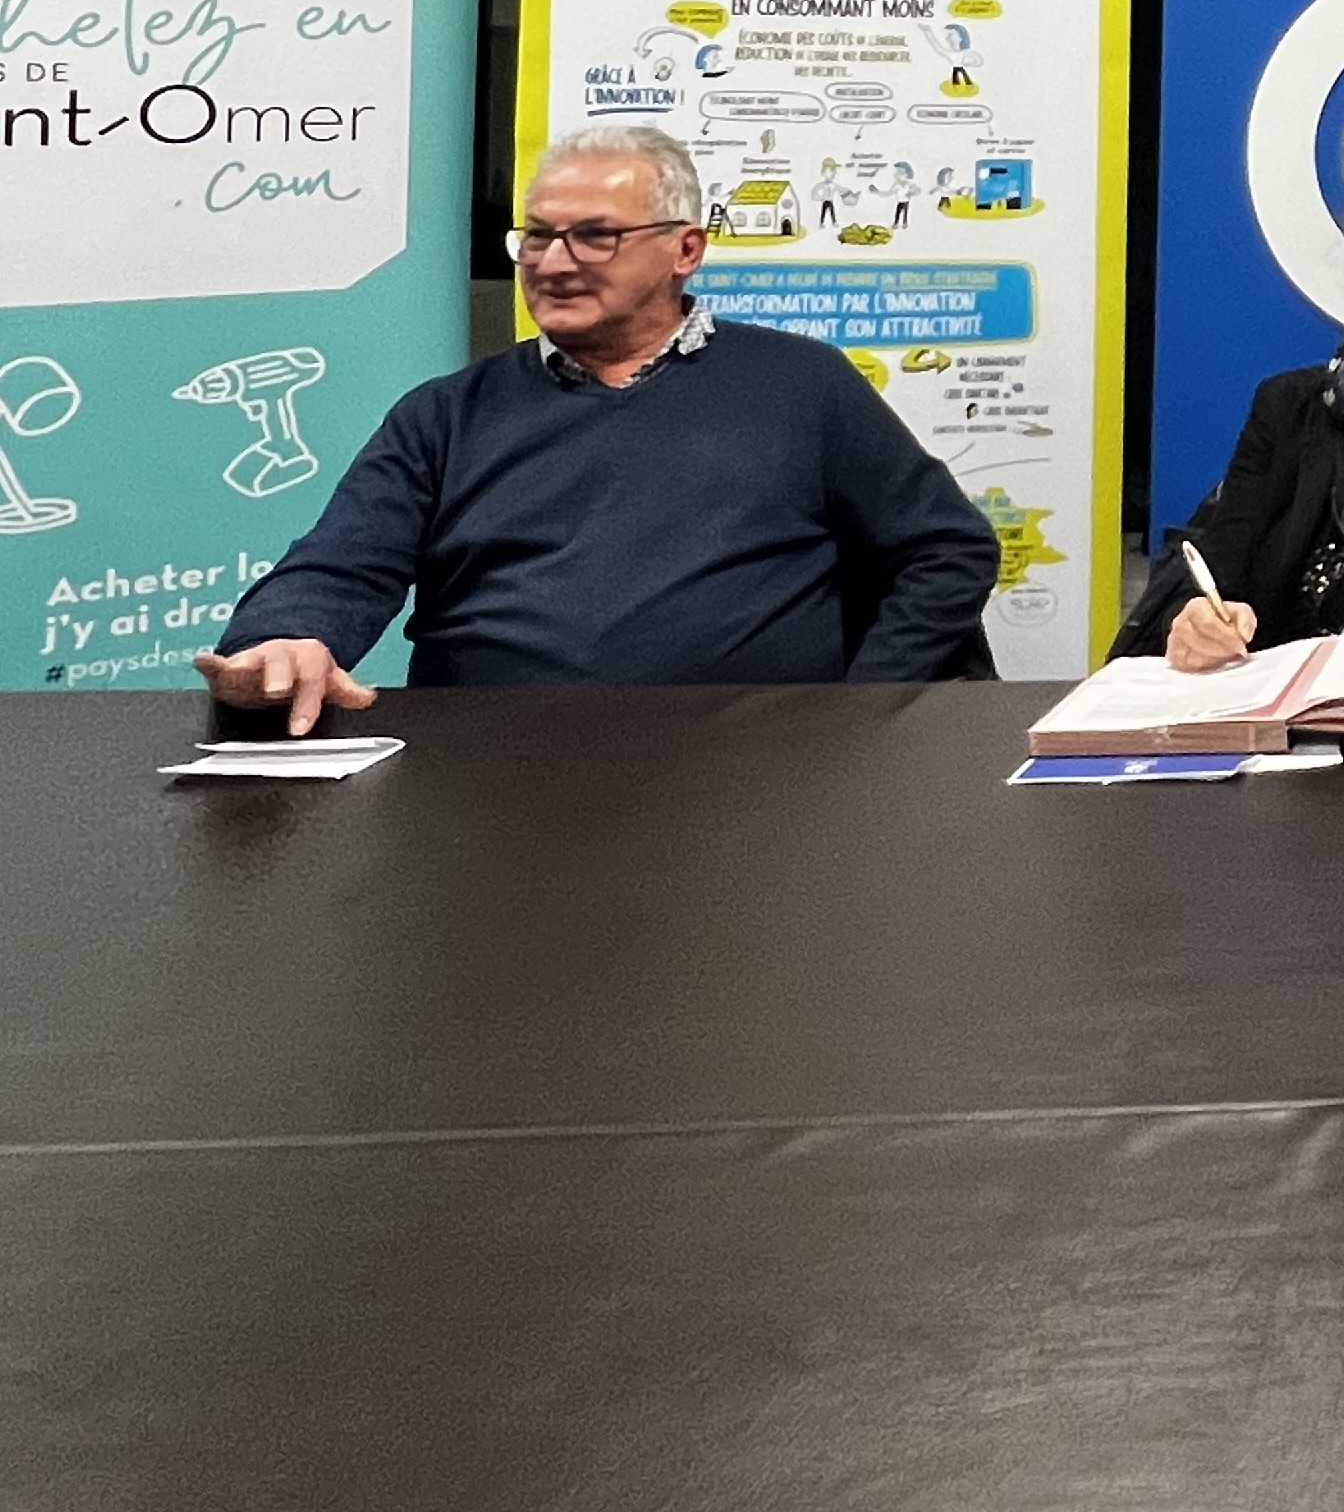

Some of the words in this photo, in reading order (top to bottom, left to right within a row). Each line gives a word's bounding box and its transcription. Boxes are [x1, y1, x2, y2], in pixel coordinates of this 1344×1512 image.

[297, 6, 391, 39] en
[882, 0, 935, 18] MOINS
[26, 62, 69, 82] DE
[46, 563, 225, 606] Acheter
[40, 614, 95, 655] j'y
[110, 604, 149, 636] ai
